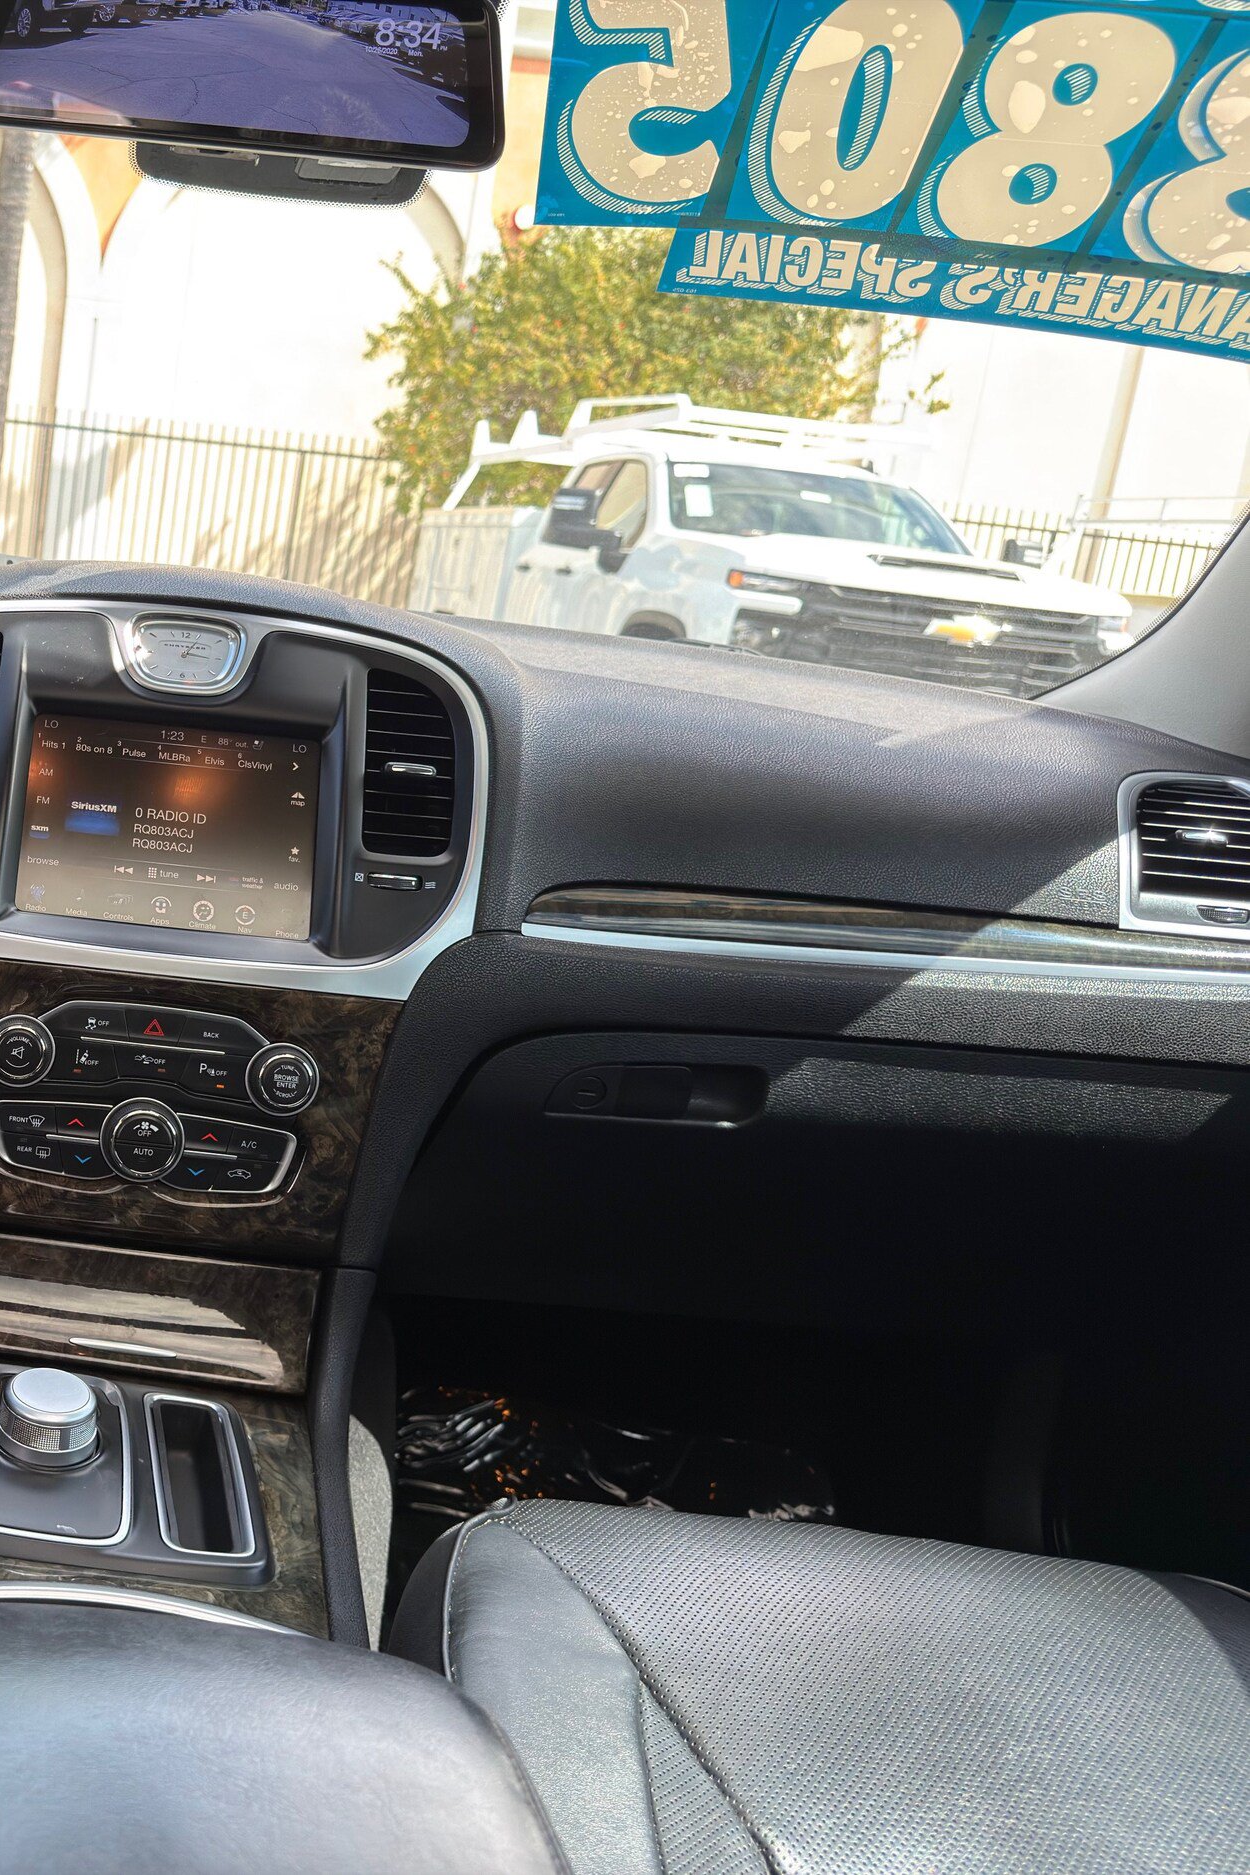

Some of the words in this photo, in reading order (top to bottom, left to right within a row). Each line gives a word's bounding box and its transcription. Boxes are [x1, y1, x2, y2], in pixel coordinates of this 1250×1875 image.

[376, 18, 441, 49] 8:34
[365, 46, 398, 55] 10/26/2020
[408, 49, 423, 57] Mon.
[44, 720, 59, 728] LO
[161, 730, 185, 741] 1:23
[42, 740, 59, 749] Hits
[76, 743, 92, 753] 80s
[293, 744, 307, 753] LO
[122, 748, 147, 758] Pulse
[205, 757, 225, 766] Elvis
[238, 760, 273, 771] ClsVinyl
[39, 768, 54, 776] AM
[36, 796, 50, 804] FM
[71, 801, 117, 813] SiriusXM
[146, 808, 190, 823] RADIO
[193, 813, 207, 825] ID
[30, 824, 49, 832] sxm
[133, 824, 194, 839] RQ803ACJ
[132, 838, 193, 853] RQ803ACJ
[27, 855, 59, 866] browse
[160, 870, 179, 879] tune
[274, 881, 299, 891] audio
[25, 903, 47, 912] Radio
[65, 907, 88, 916] Media
[103, 912, 134, 921] Controls
[150, 917, 169, 926] Apps
[188, 921, 216, 930] Climate
[237, 926, 252, 934] Nav
[275, 930, 299, 938] Phone
[203, 1031, 220, 1039] BACK
[9, 1036, 30, 1044] VOLUME
[273, 1074, 299, 1082] BROWSE
[276, 1090, 295, 1098] SCROLL
[9, 1115, 28, 1123] FRONT
[137, 1129, 152, 1138] OFF
[16, 1145, 33, 1153] REAR
[241, 1140, 257, 1149] A/C
[133, 1148, 154, 1156] AUTO
